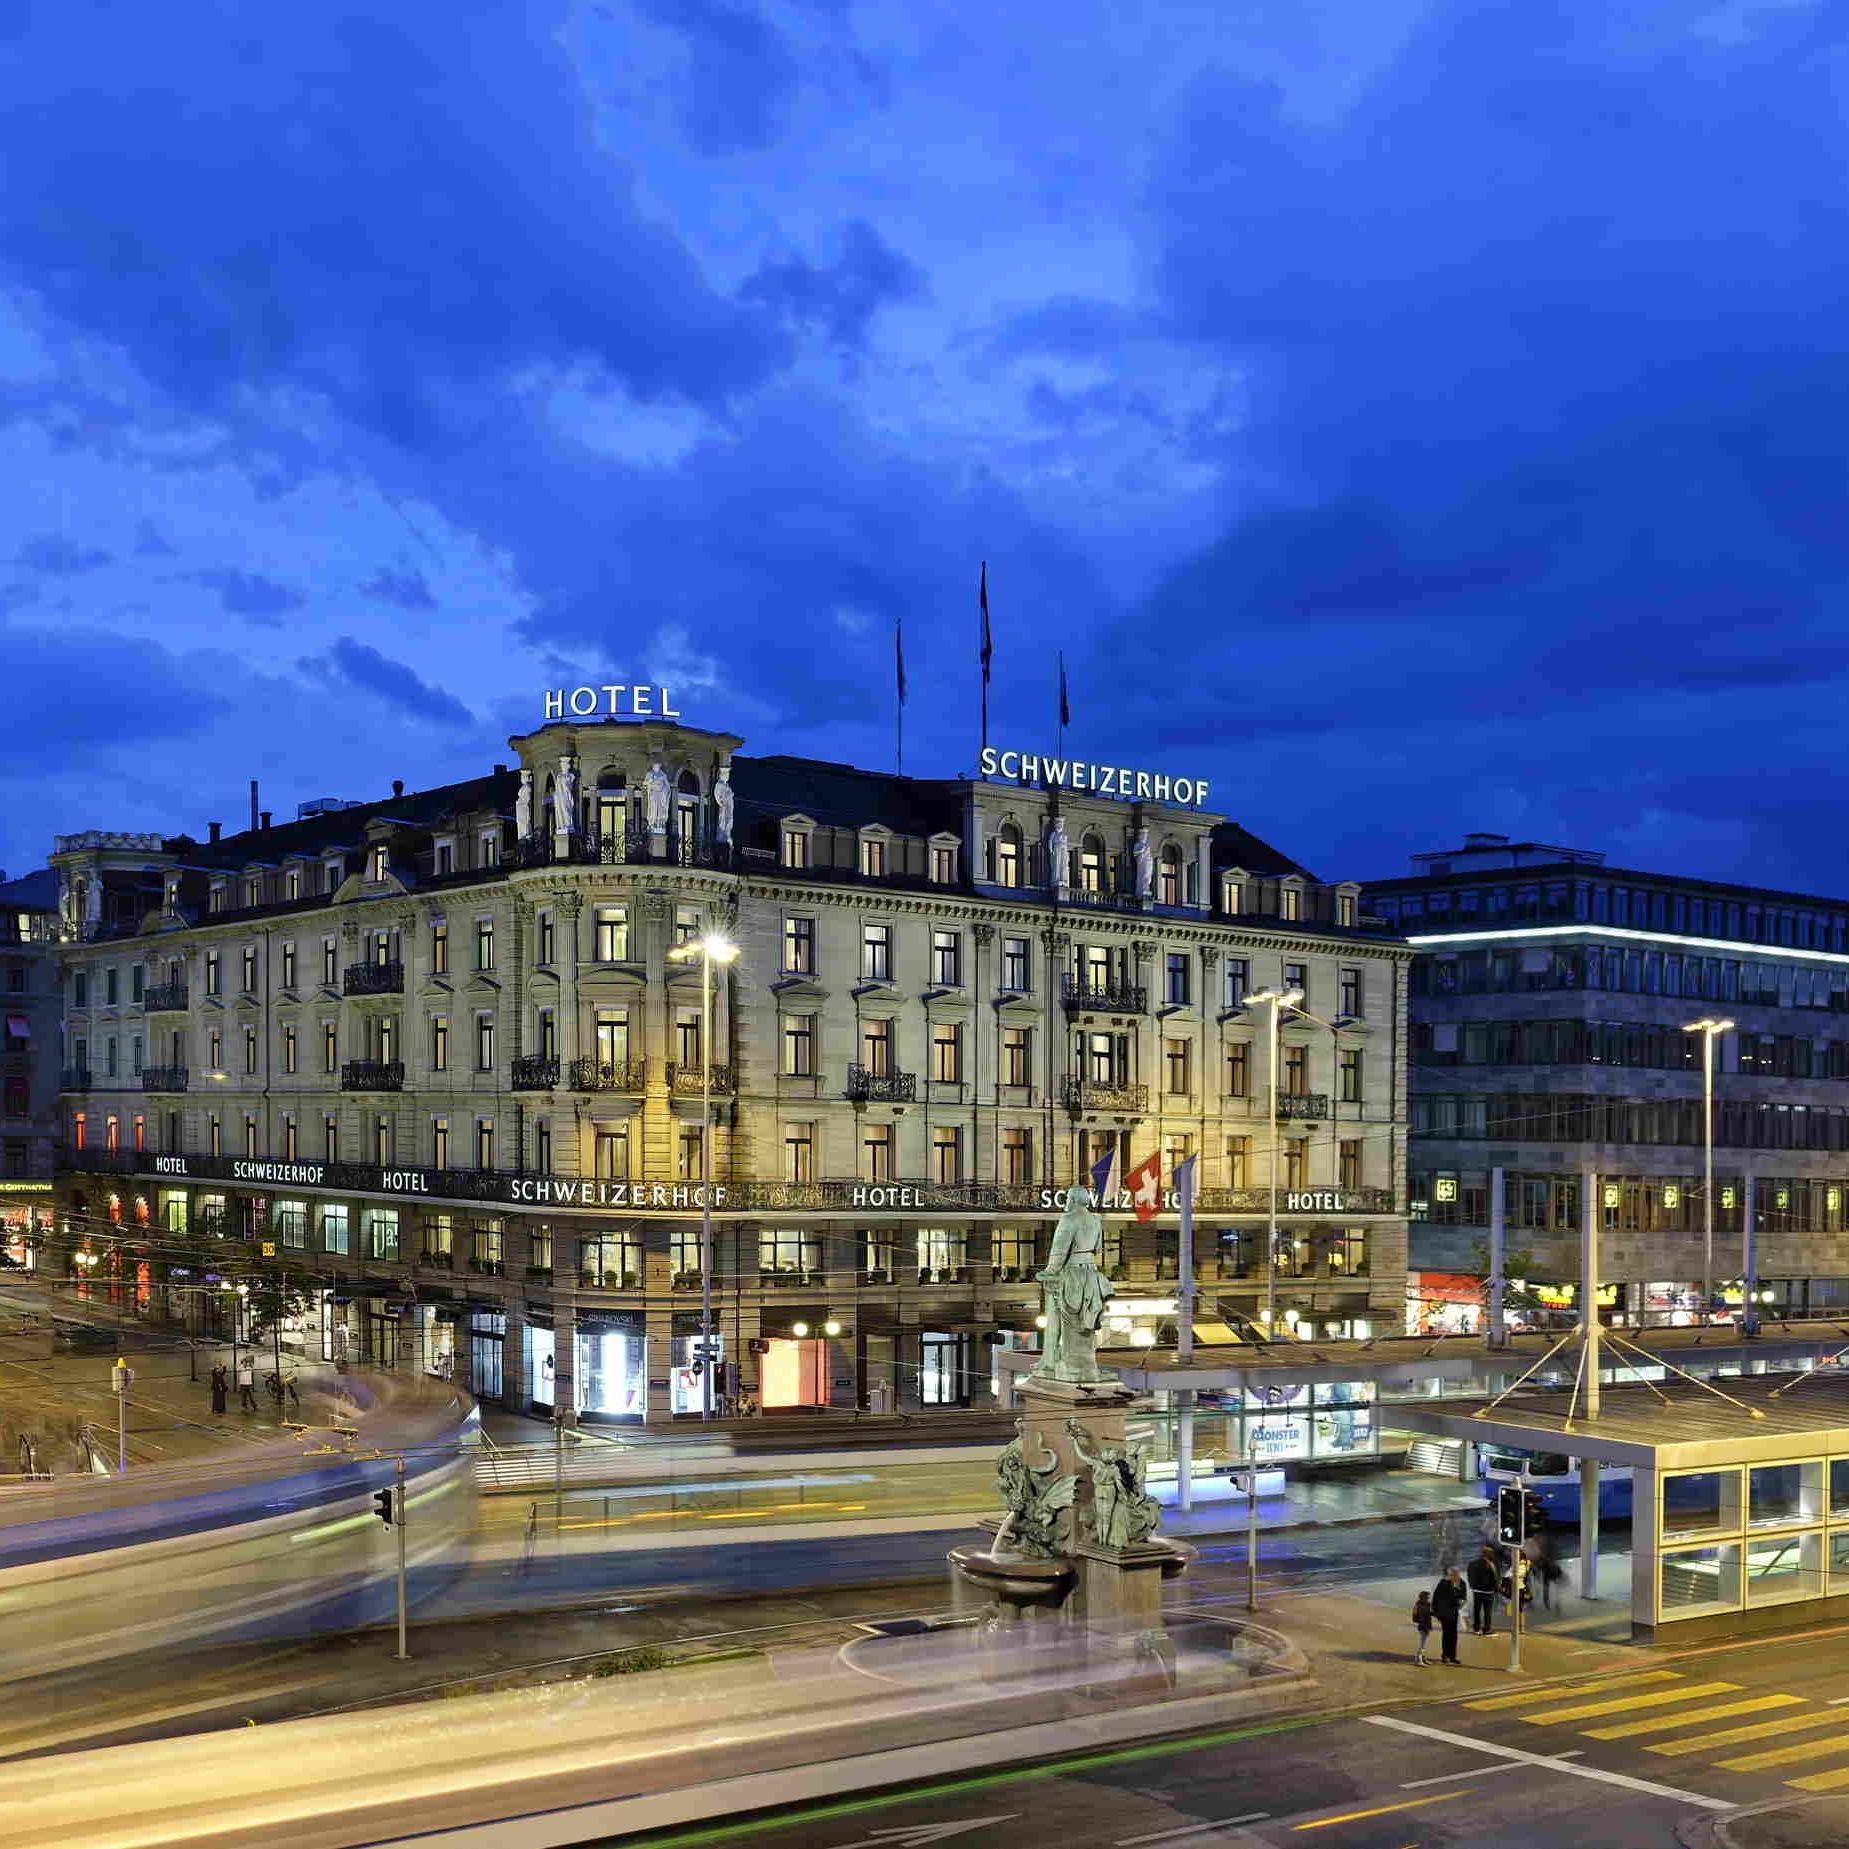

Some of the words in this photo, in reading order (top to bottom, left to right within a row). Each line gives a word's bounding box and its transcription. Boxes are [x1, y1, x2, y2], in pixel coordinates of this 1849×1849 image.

[545, 685, 680, 719] HOTEL
[981, 747, 1209, 806] SCHWEIZERHOF
[156, 1157, 188, 1174] HOTEL
[233, 1161, 324, 1184] SCHWEIZERHOF
[382, 1171, 429, 1192] HOTEL
[511, 1180, 727, 1207] SCHWEIZERHOF
[853, 1187, 925, 1207] HOTEL
[1288, 1193, 1344, 1210] HOTEL
